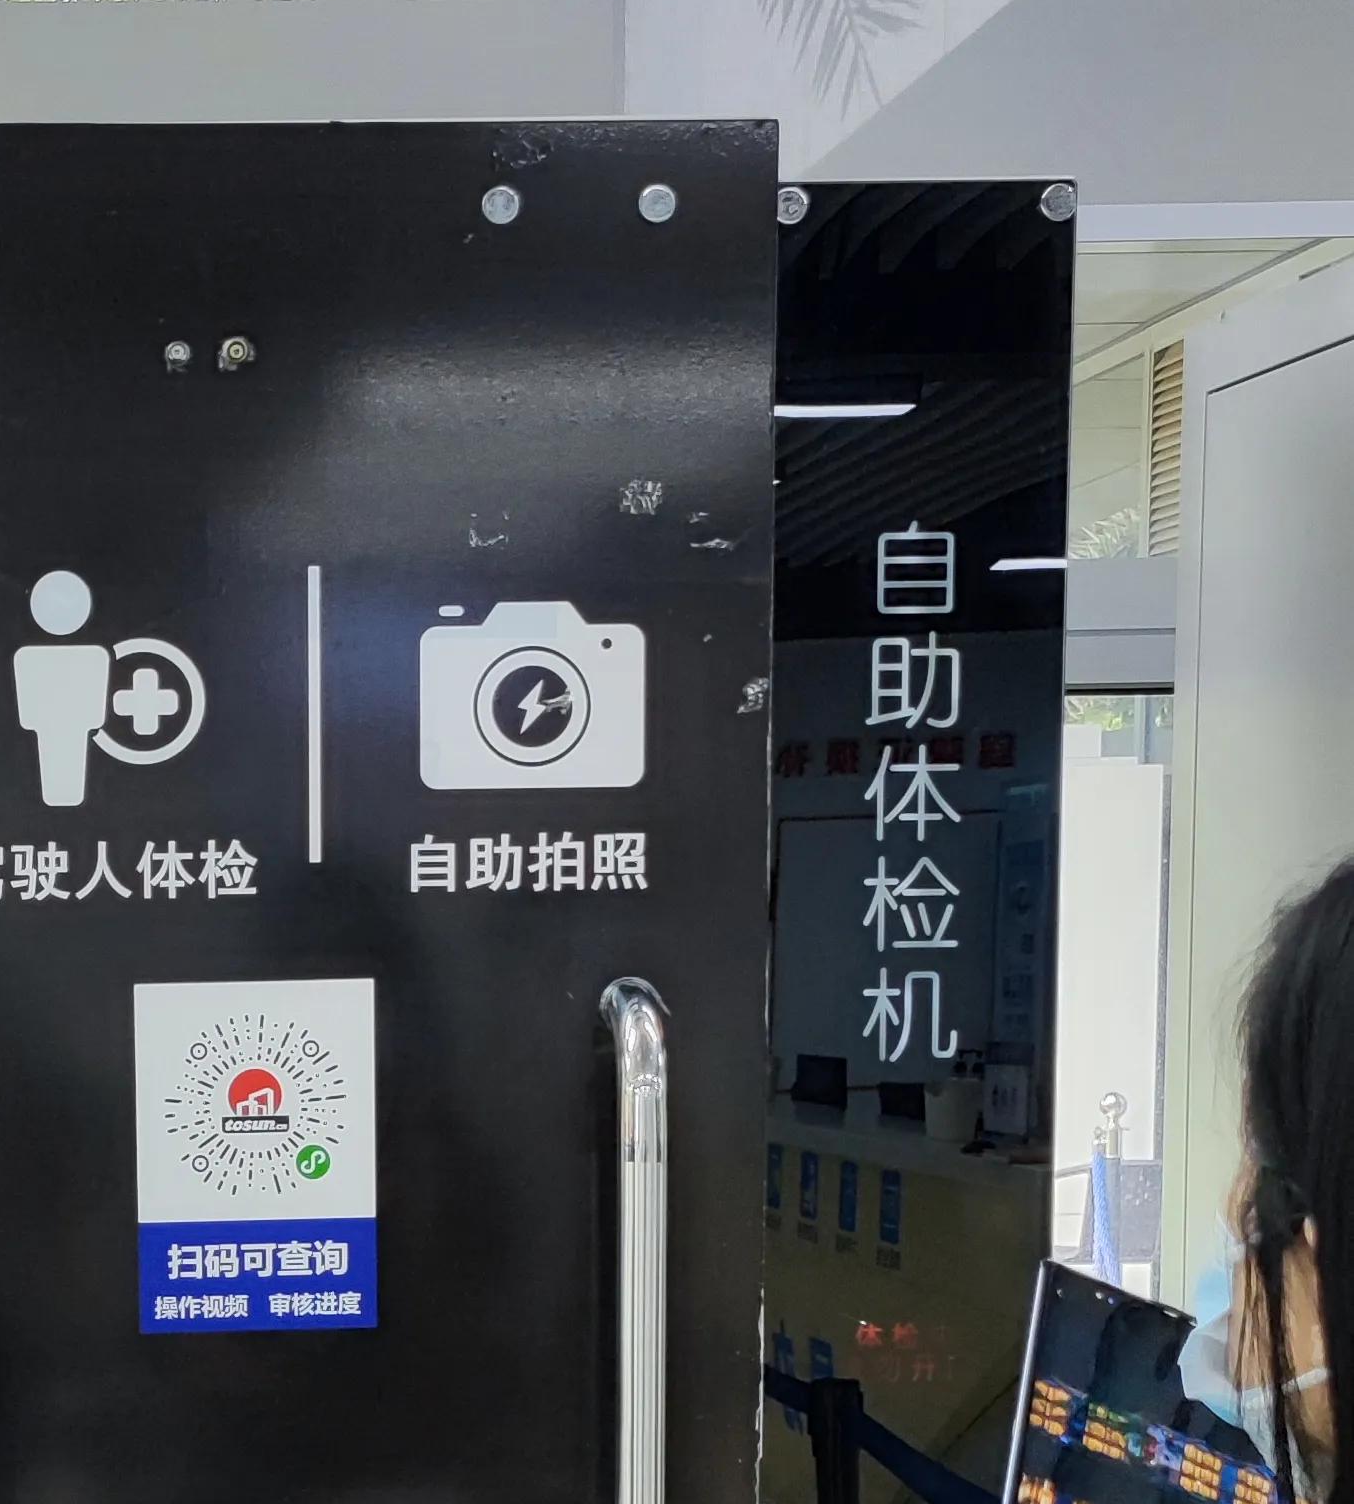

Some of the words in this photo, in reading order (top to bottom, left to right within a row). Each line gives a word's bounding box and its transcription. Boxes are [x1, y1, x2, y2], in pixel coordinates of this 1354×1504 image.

[863, 521, 961, 1063] 自助体检机
[409, 831, 649, 893] 自助拍照
[167, 1239, 349, 1280] 扫码可查询
[154, 1294, 250, 1320] 操作视频
[268, 1291, 362, 1317] 审核进度
